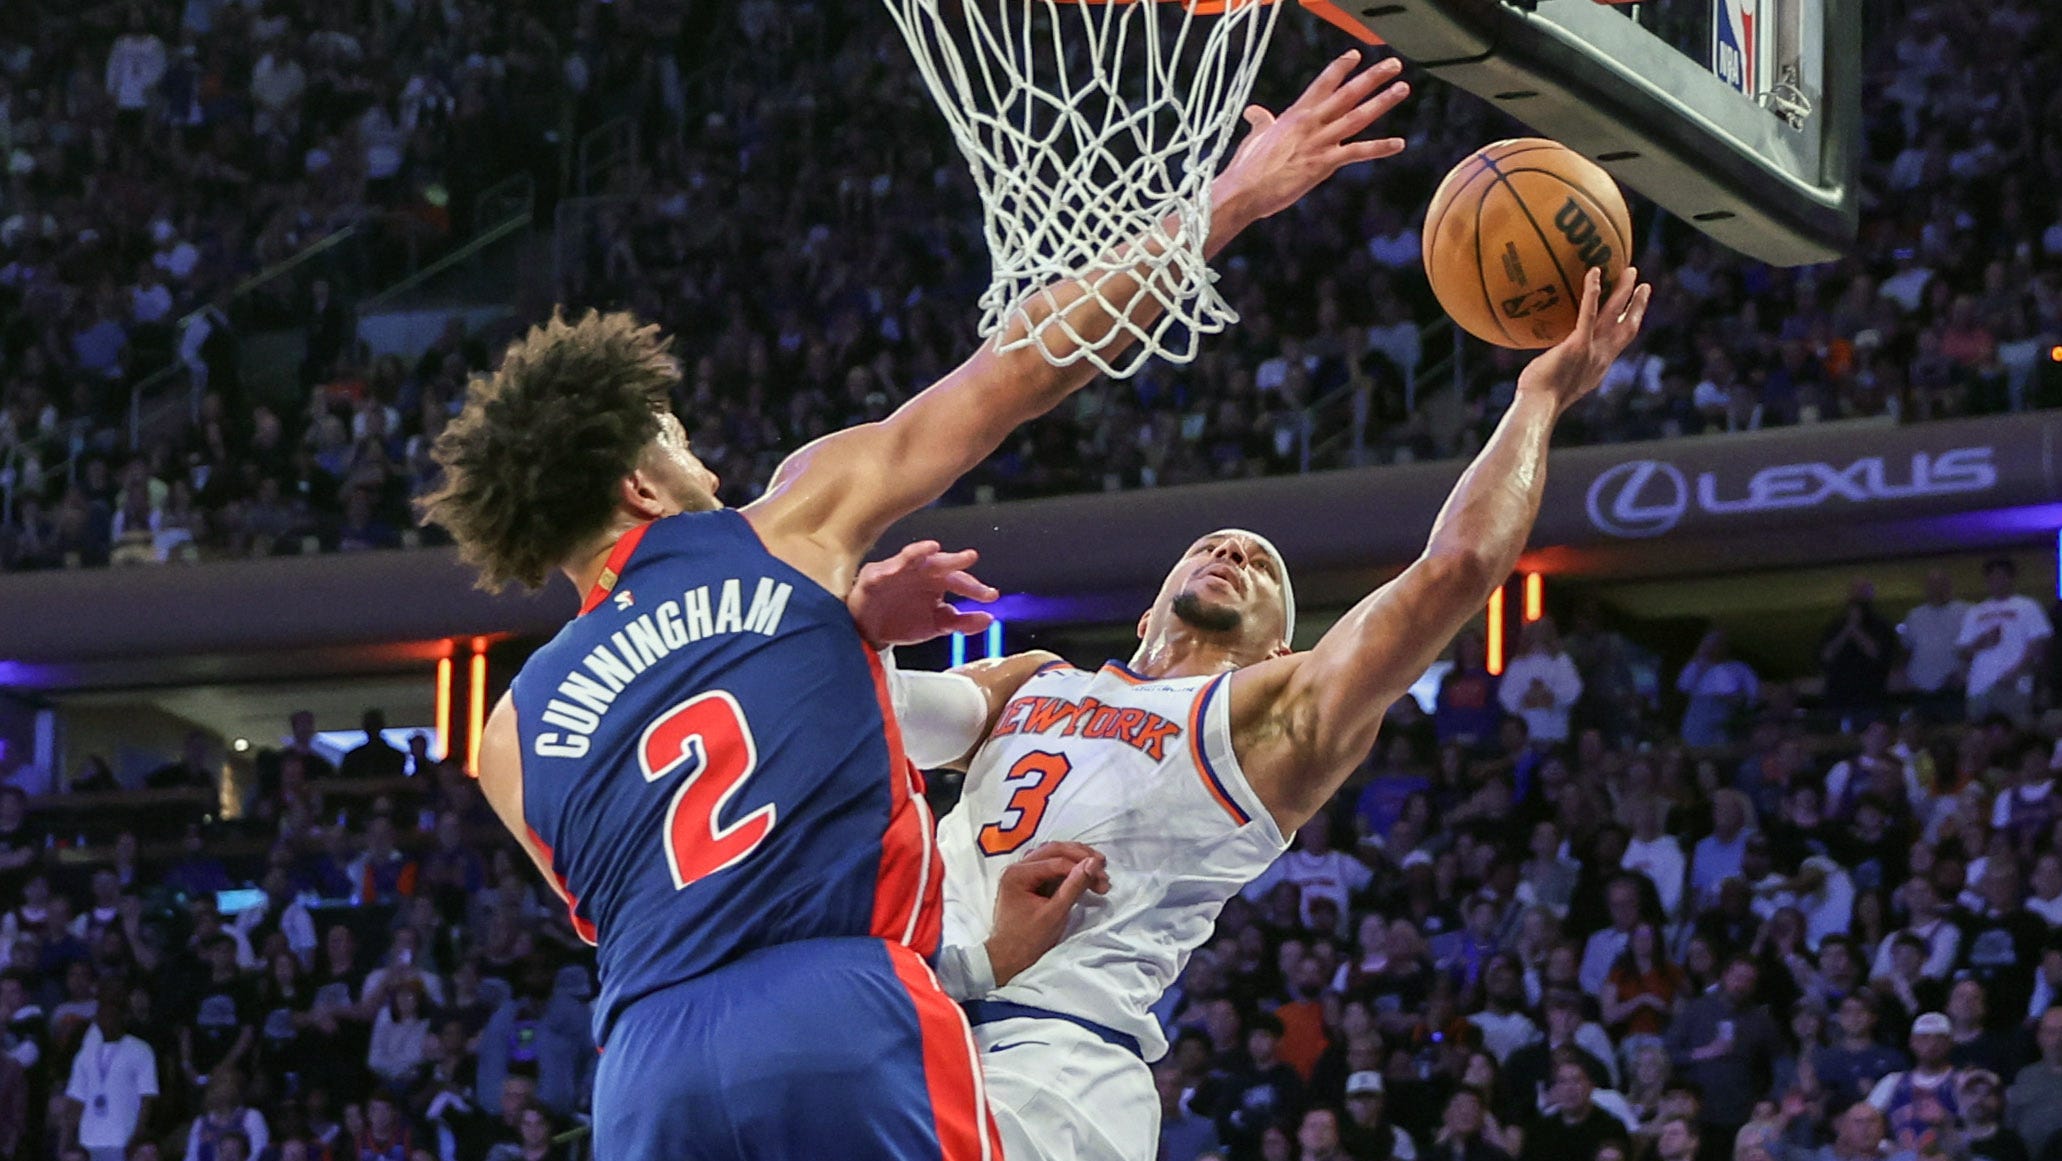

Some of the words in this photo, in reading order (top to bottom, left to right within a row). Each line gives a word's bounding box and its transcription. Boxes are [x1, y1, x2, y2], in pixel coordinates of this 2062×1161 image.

[1719, 40, 1740, 86] NBA
[1697, 446, 1997, 514] LEXUS
[535, 576, 793, 759] CUNNINGHAM
[637, 689, 777, 891] 2
[977, 749, 1072, 858] 3
